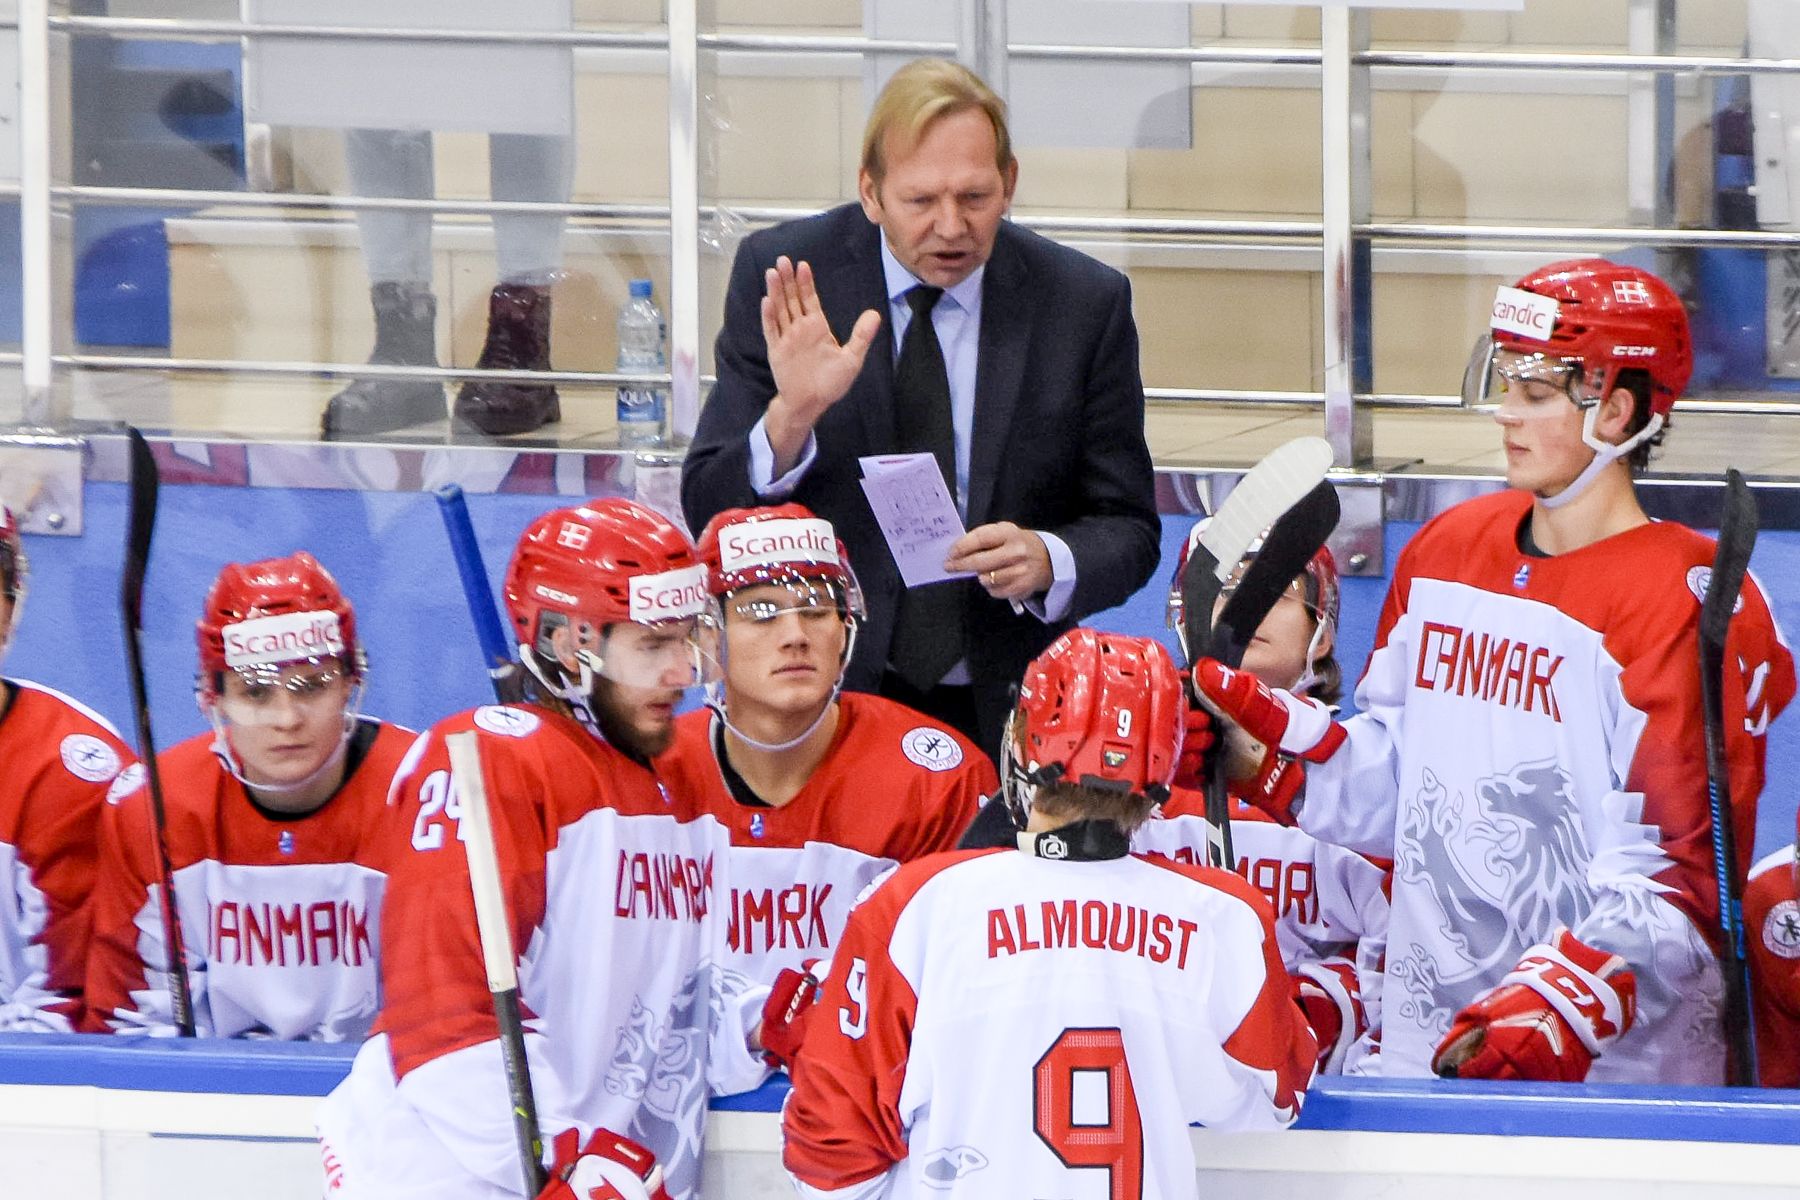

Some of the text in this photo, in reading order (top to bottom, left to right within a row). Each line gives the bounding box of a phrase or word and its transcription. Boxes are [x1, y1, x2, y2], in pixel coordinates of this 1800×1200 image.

[1492, 302, 1547, 329] candic
[1612, 345, 1657, 356] CCM
[727, 529, 833, 560] Scandic
[636, 572, 708, 611] Scand
[229, 619, 339, 656] Scandic
[1116, 708, 1133, 738] 9
[987, 899, 1199, 971] ALMQUIST
[838, 956, 868, 1041] 9
[1032, 1026, 1145, 1200] 9
